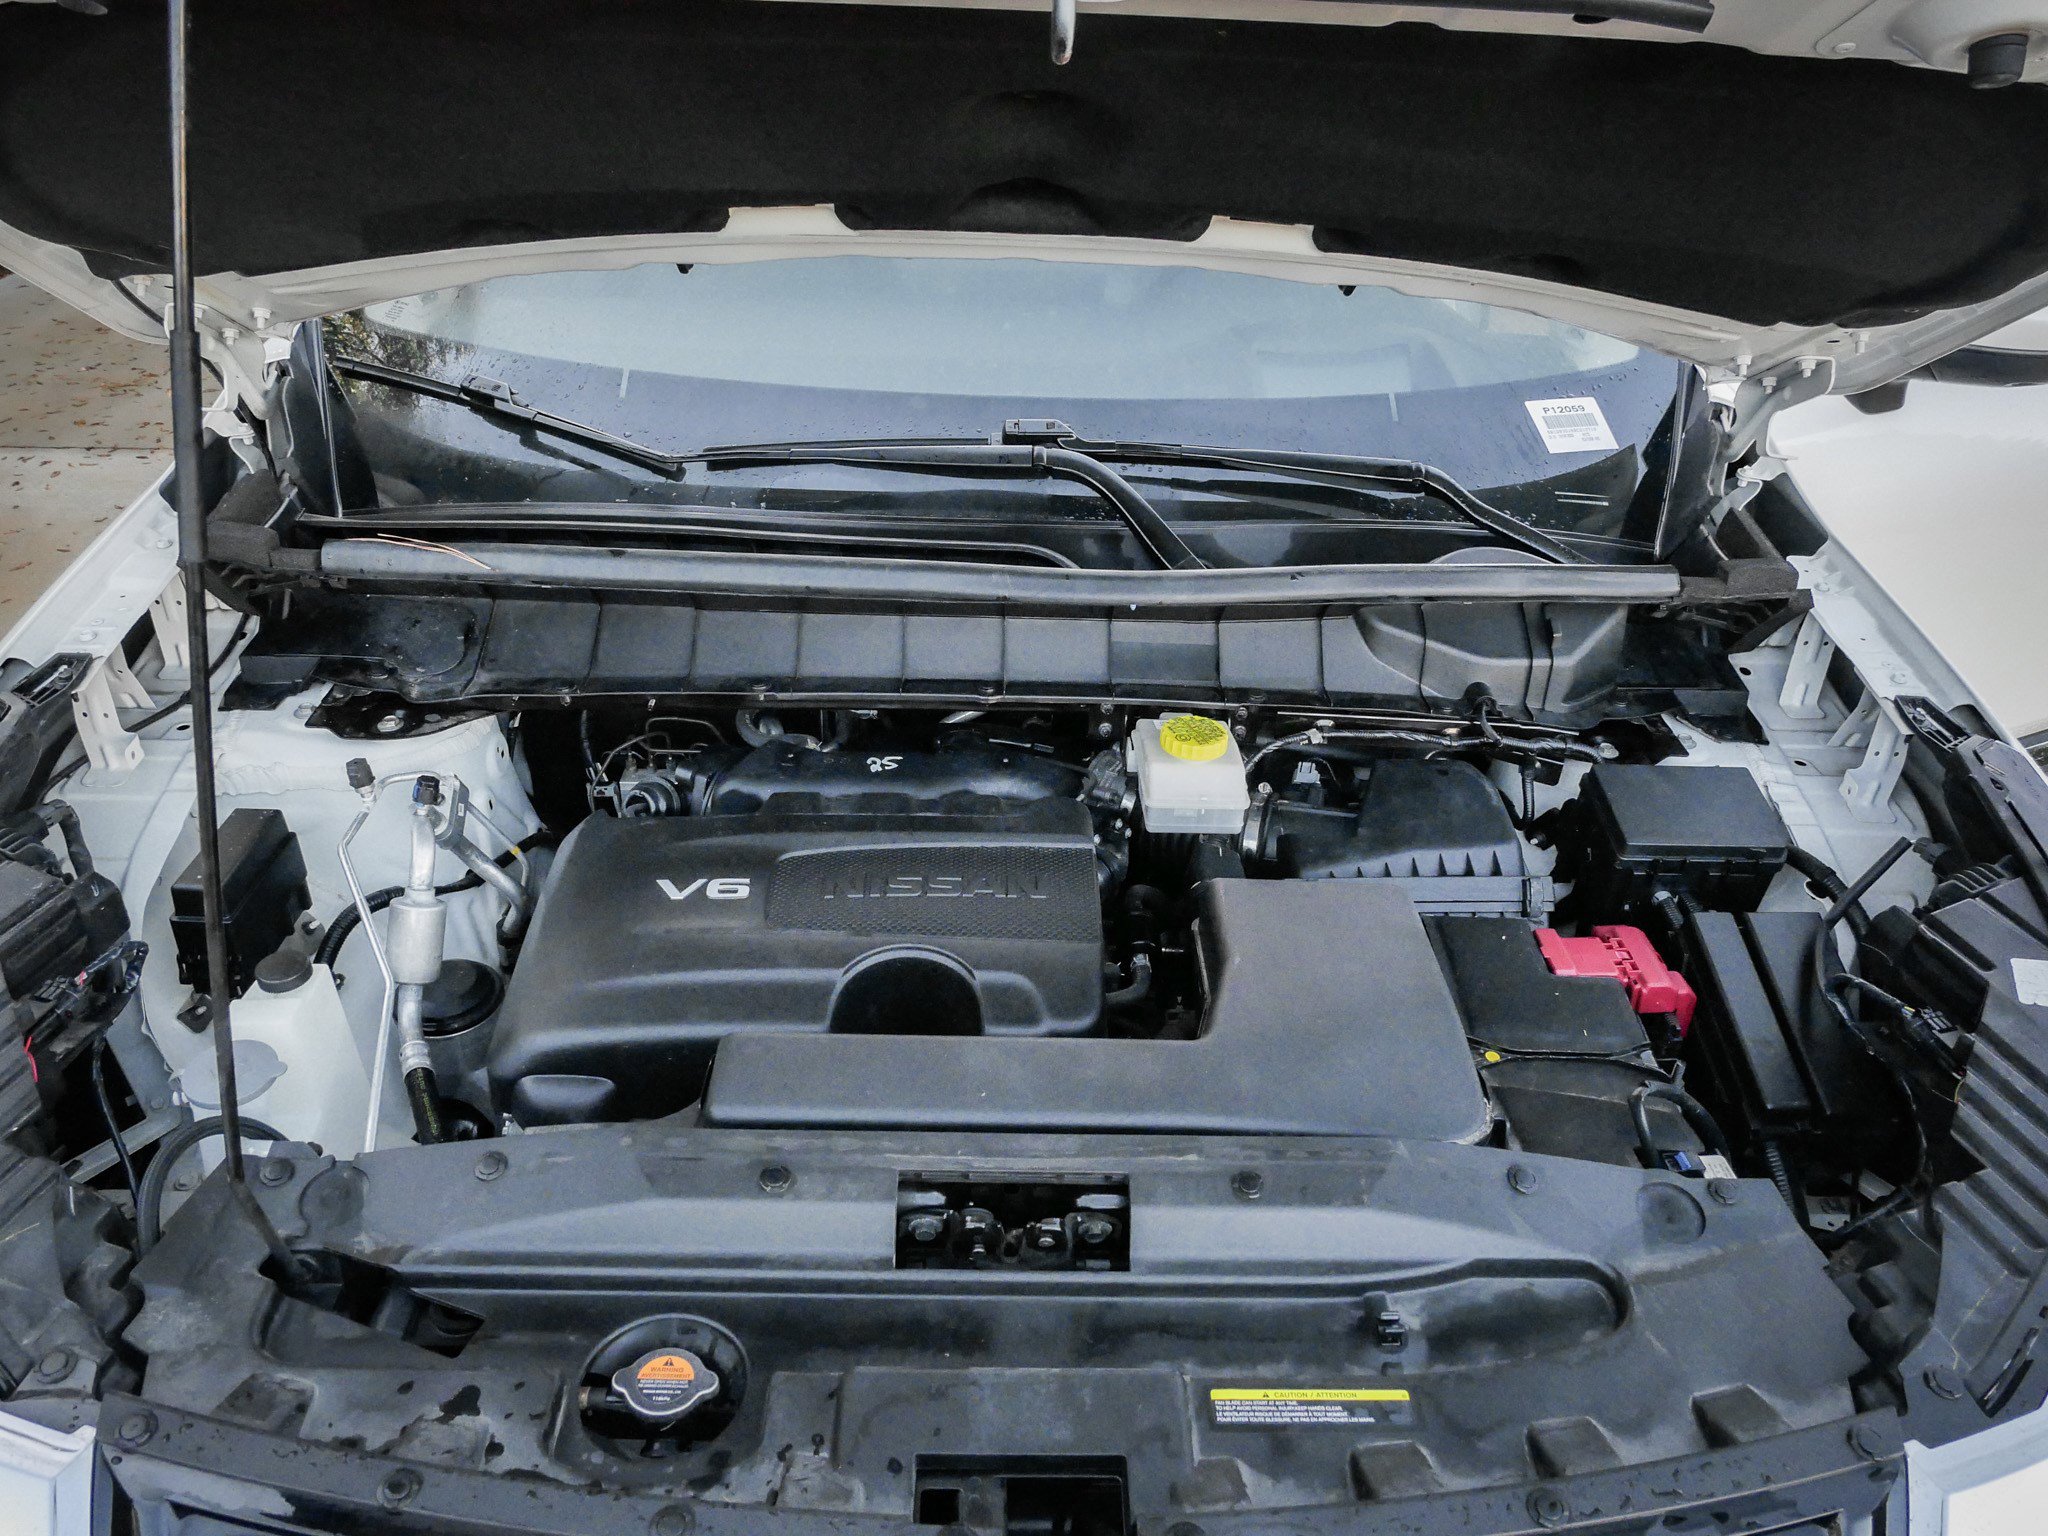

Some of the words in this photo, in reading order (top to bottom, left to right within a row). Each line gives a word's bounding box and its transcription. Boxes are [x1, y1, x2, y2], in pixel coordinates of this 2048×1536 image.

[1542, 405, 1586, 414] P12059
[656, 878, 751, 900] V6
[823, 873, 1048, 899] NISSAN
